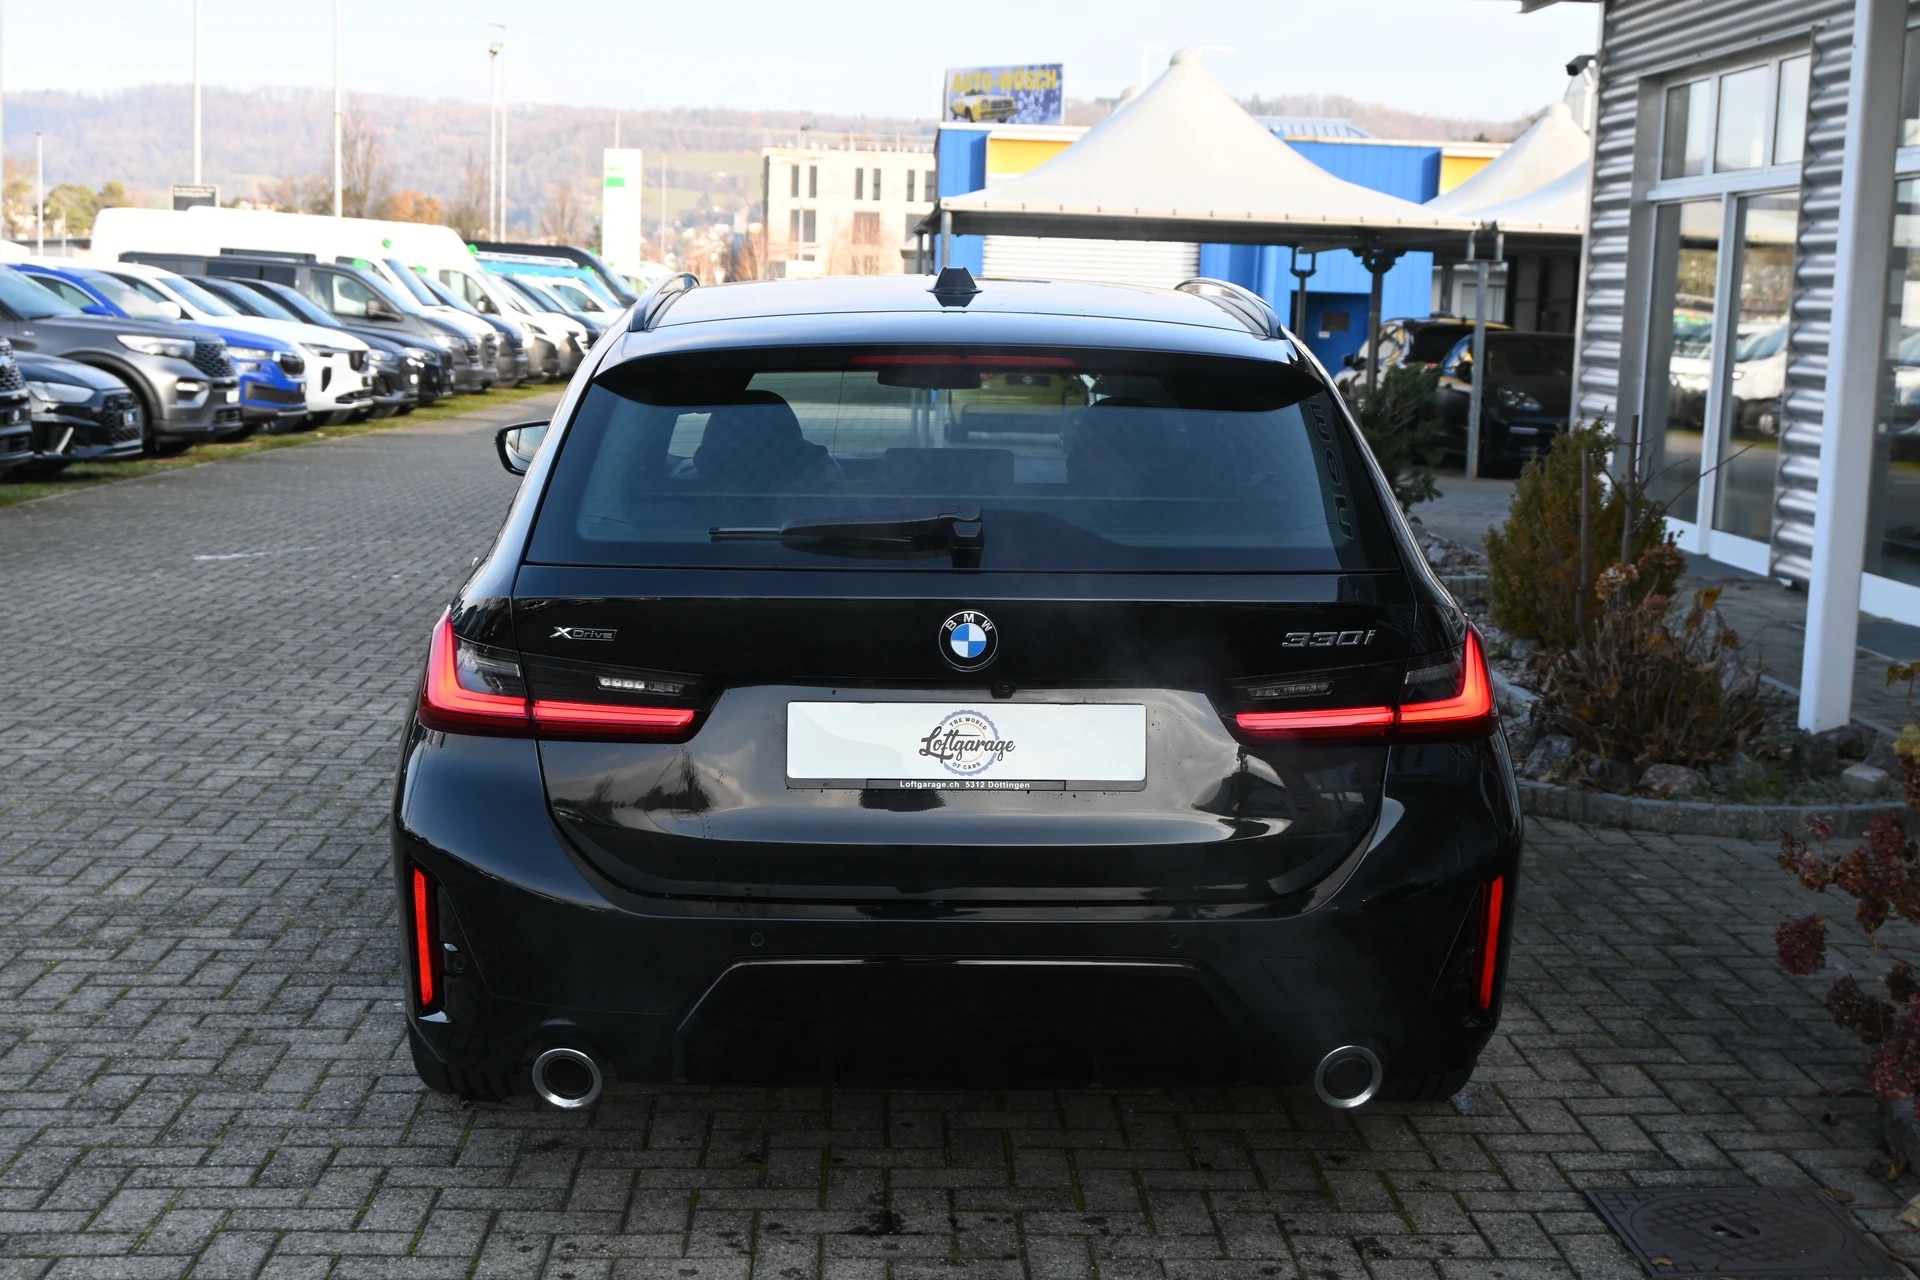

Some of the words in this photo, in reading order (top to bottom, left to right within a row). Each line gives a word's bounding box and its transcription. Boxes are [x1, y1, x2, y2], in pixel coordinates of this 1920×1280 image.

[952, 66, 1057, 93] AUTO-WÖSCH
[945, 613, 993, 632] BMW
[1281, 629, 1377, 647] 330i
[949, 717, 963, 727] THE
[965, 717, 987, 731] WORLD
[919, 725, 1016, 764] Loftgarage
[952, 761, 961, 769] OF
[963, 761, 981, 770] CARS
[900, 780, 960, 790] Loftgarage.ch
[965, 780, 985, 789] 5312
[987, 780, 1030, 790] Döttingen
